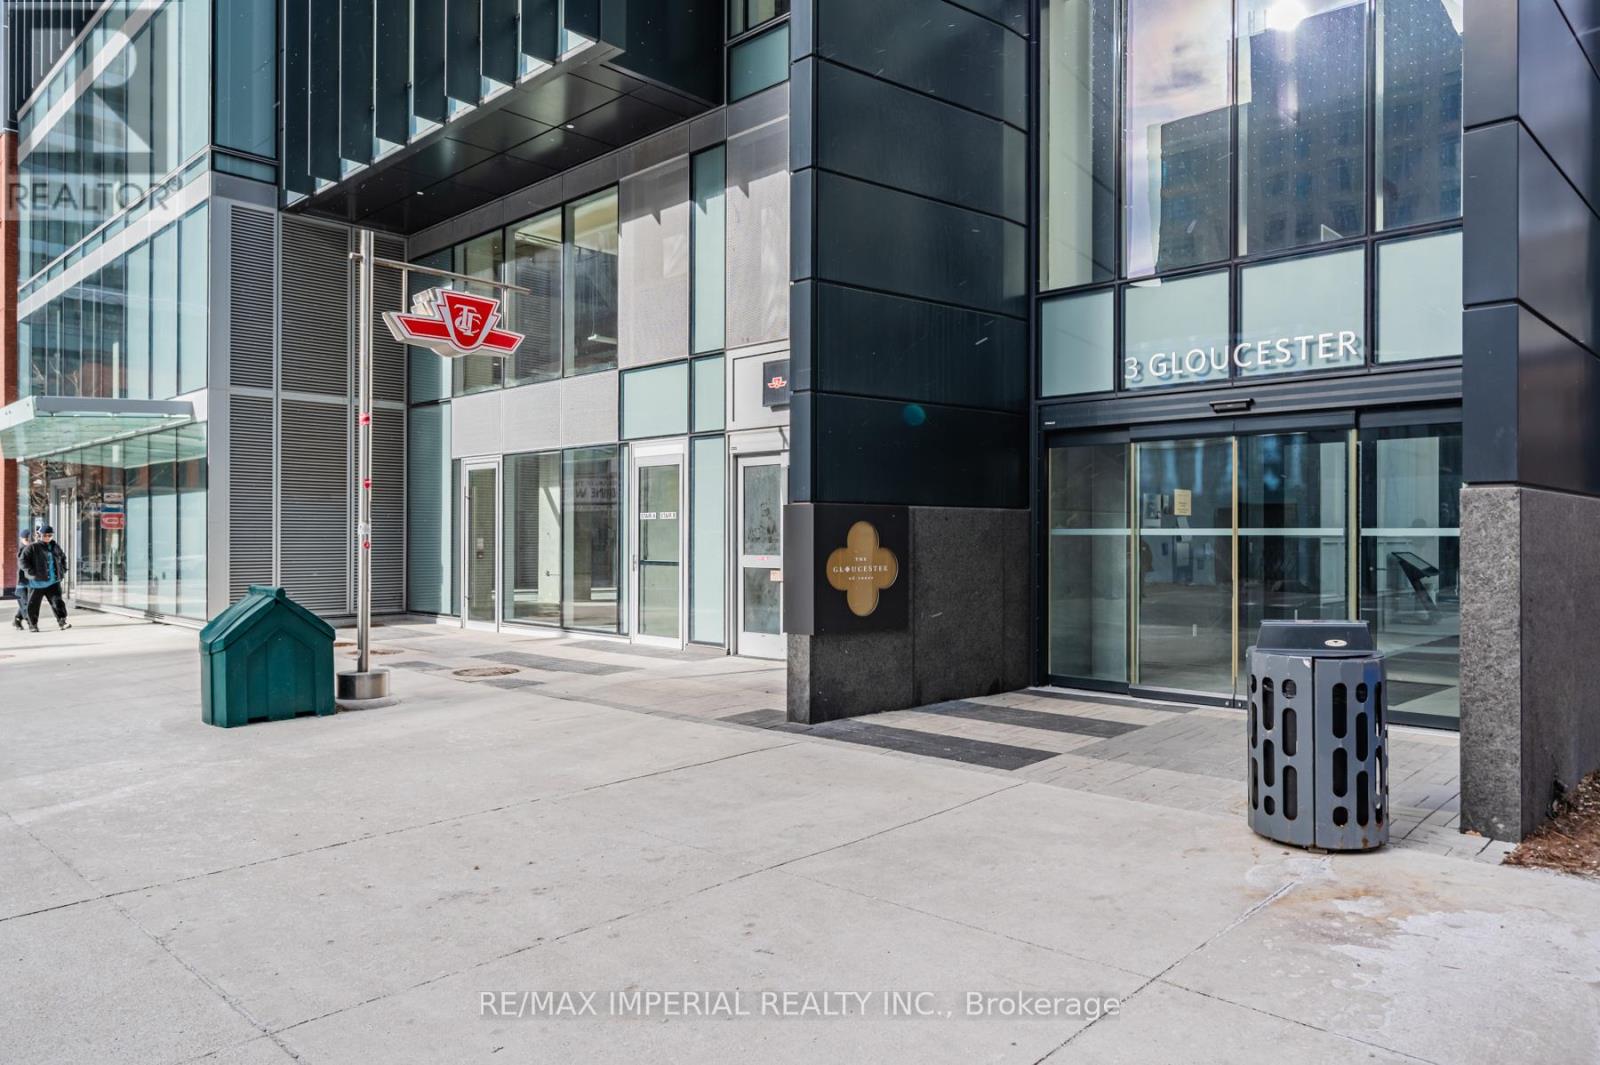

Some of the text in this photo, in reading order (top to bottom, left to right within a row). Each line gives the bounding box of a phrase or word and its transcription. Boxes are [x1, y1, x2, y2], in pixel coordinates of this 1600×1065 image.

[1124, 330, 1357, 380] 3 GLOUCESTER
[832, 565, 889, 573] GLOUCESTER
